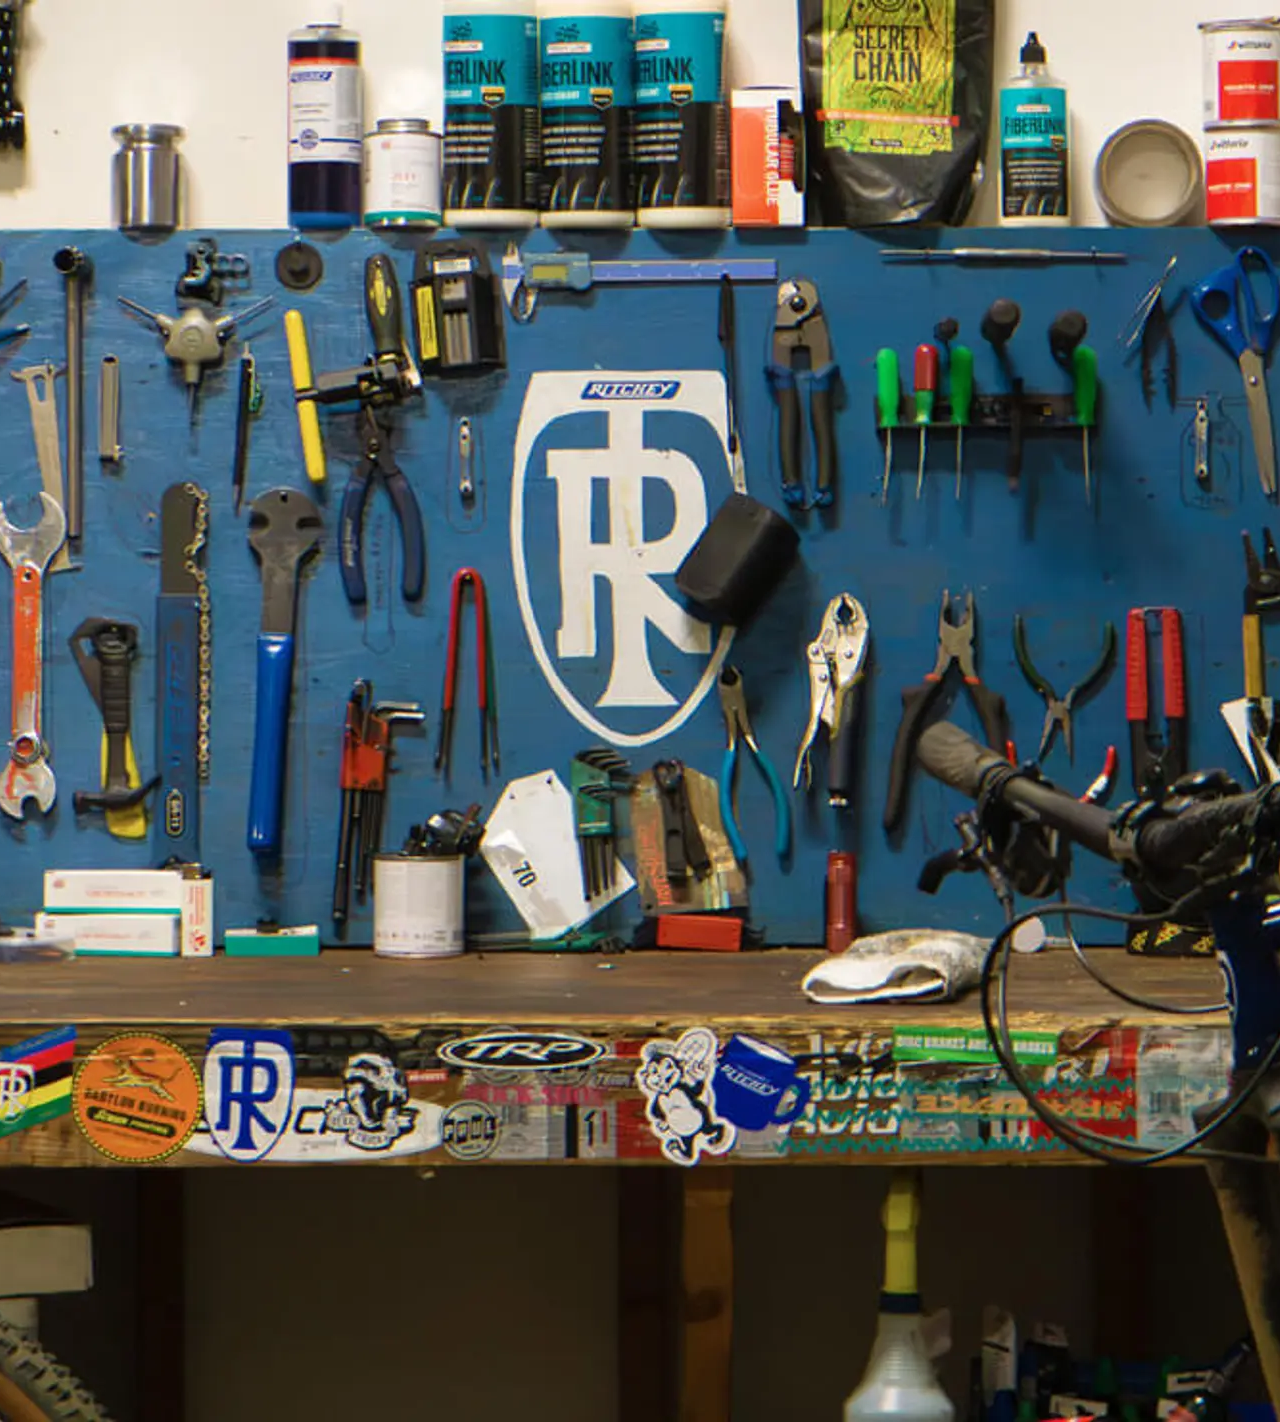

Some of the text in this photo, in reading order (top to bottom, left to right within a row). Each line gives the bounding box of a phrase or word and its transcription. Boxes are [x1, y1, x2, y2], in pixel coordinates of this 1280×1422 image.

[853, 24, 922, 50] SECRET
[853, 51, 922, 83] CHAIN
[586, 381, 676, 400] RITCHEY
[511, 859, 537, 888] 70
[465, 1040, 586, 1062] TRP
